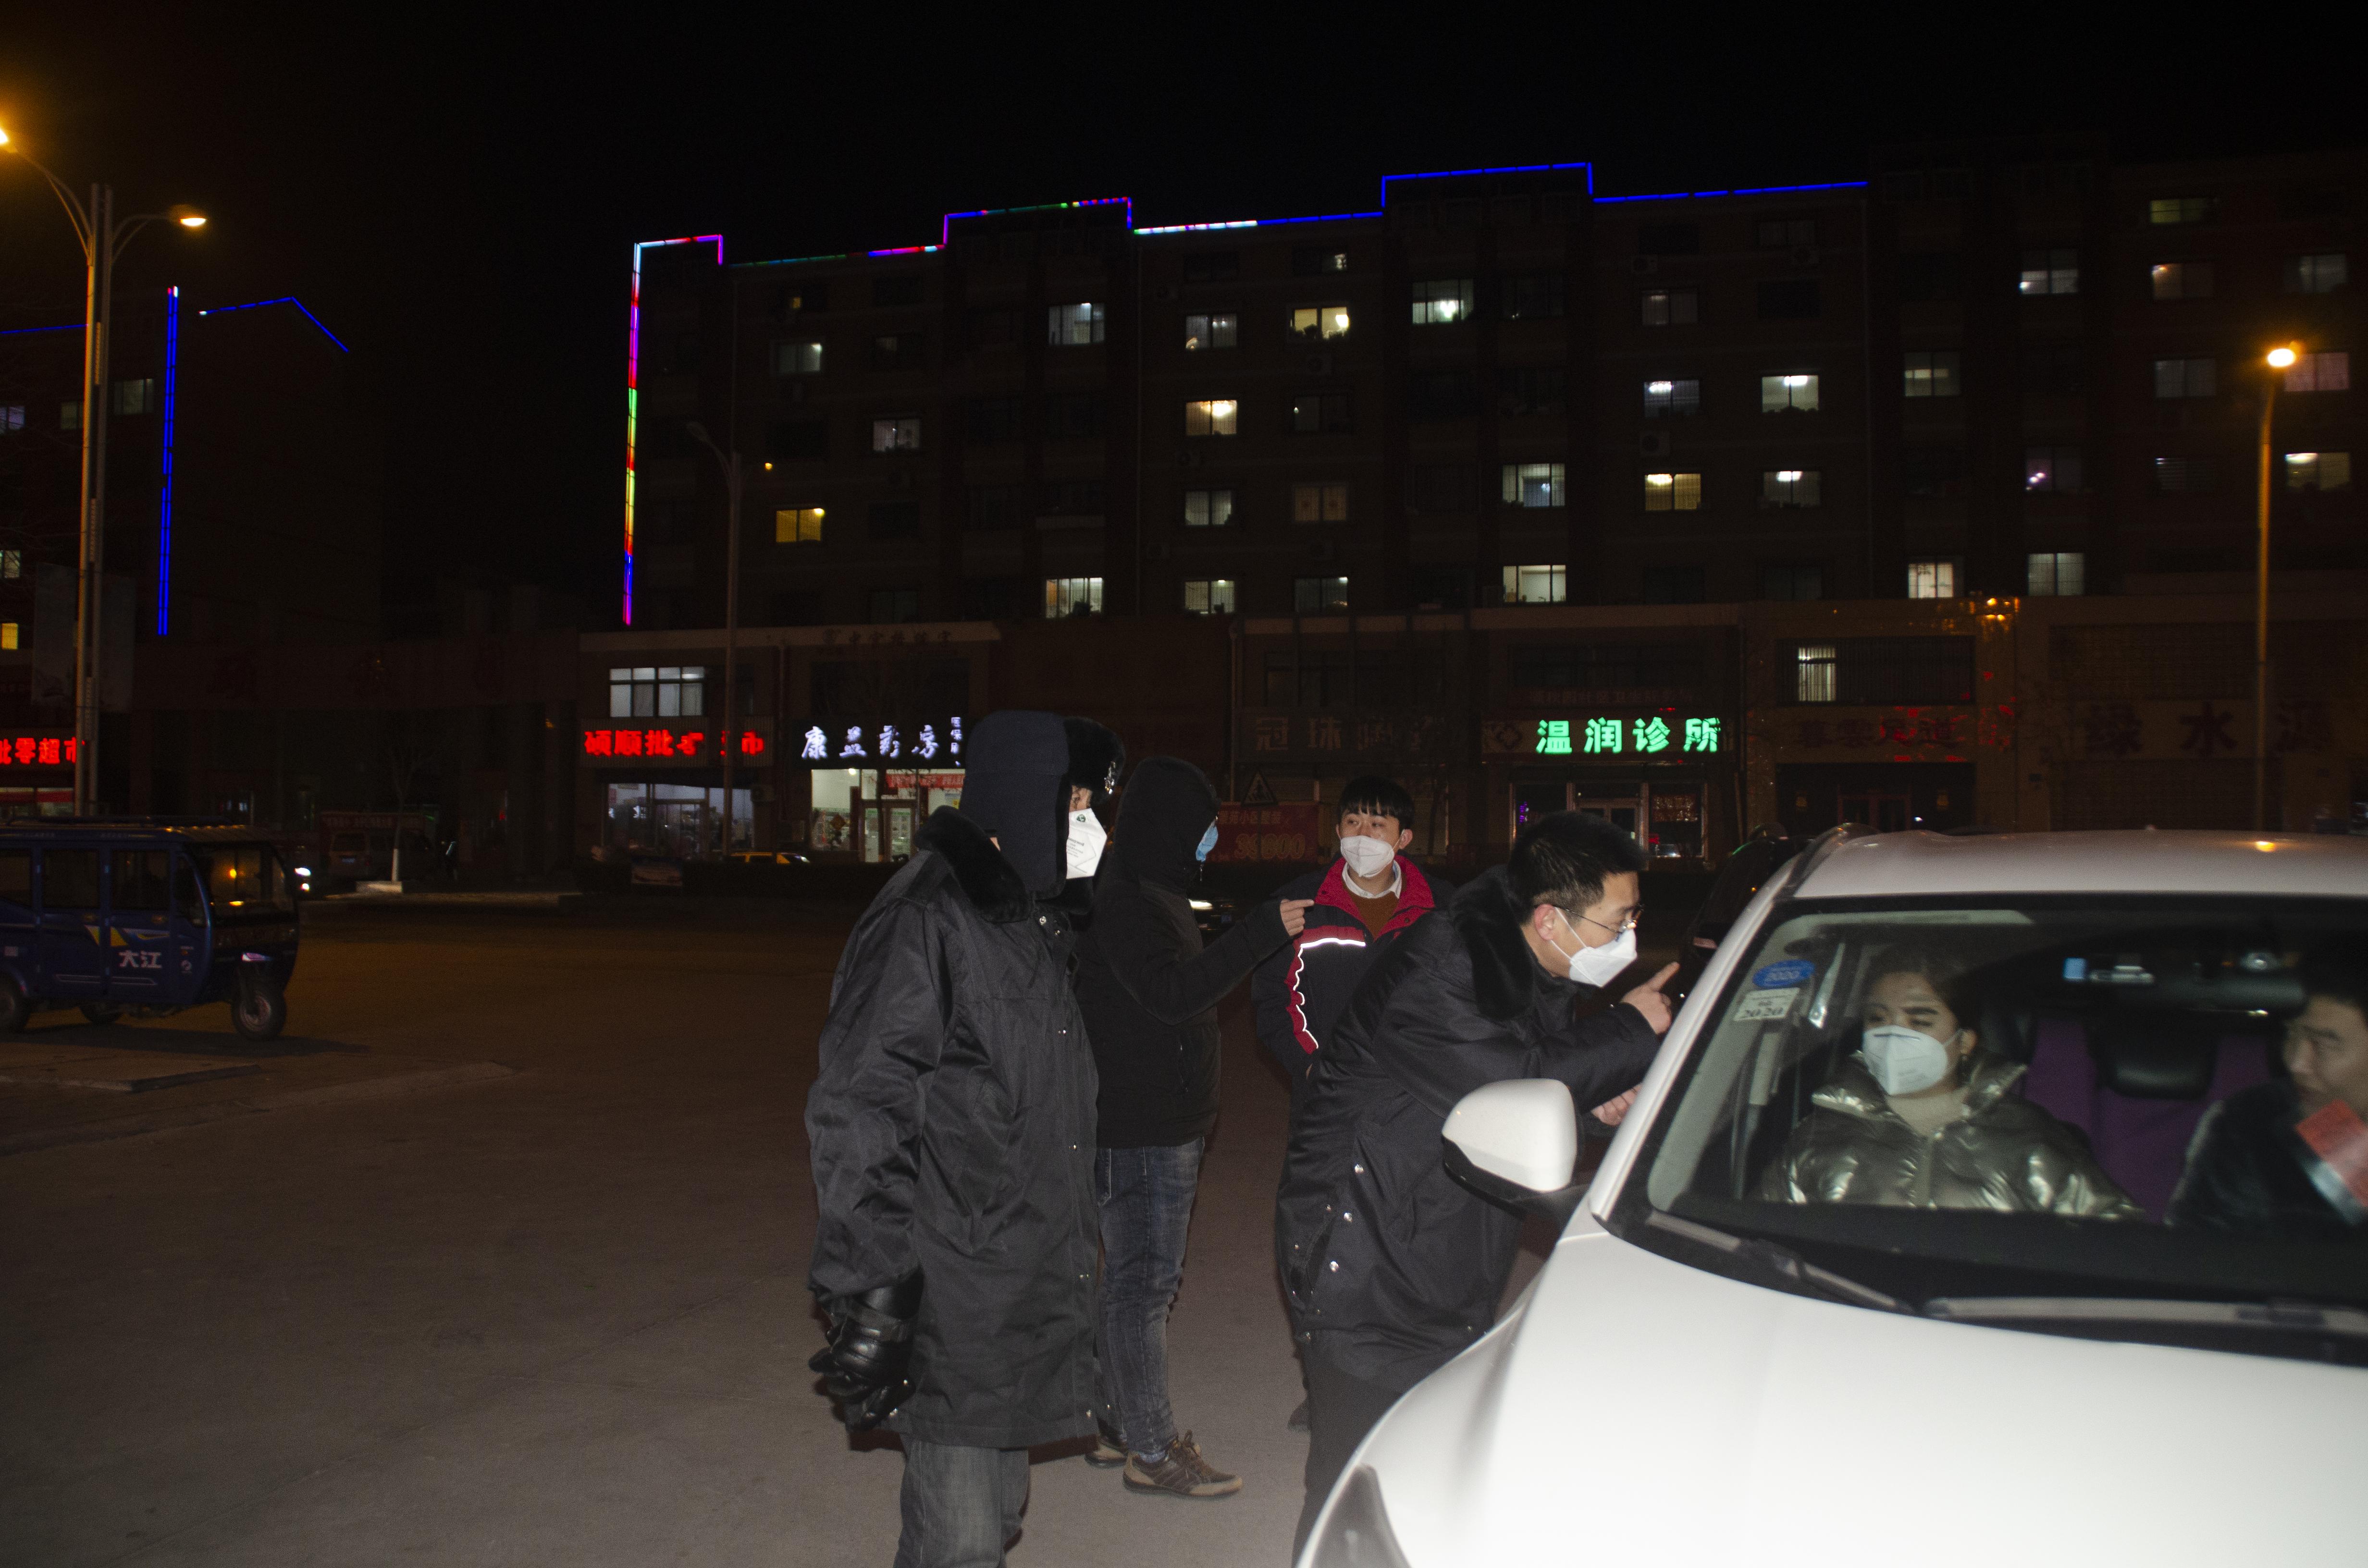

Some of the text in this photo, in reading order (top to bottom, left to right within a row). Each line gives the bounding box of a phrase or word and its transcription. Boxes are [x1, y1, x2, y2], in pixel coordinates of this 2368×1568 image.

[1536, 716, 1721, 754] 温润诊所
[117, 949, 162, 968] 大江
